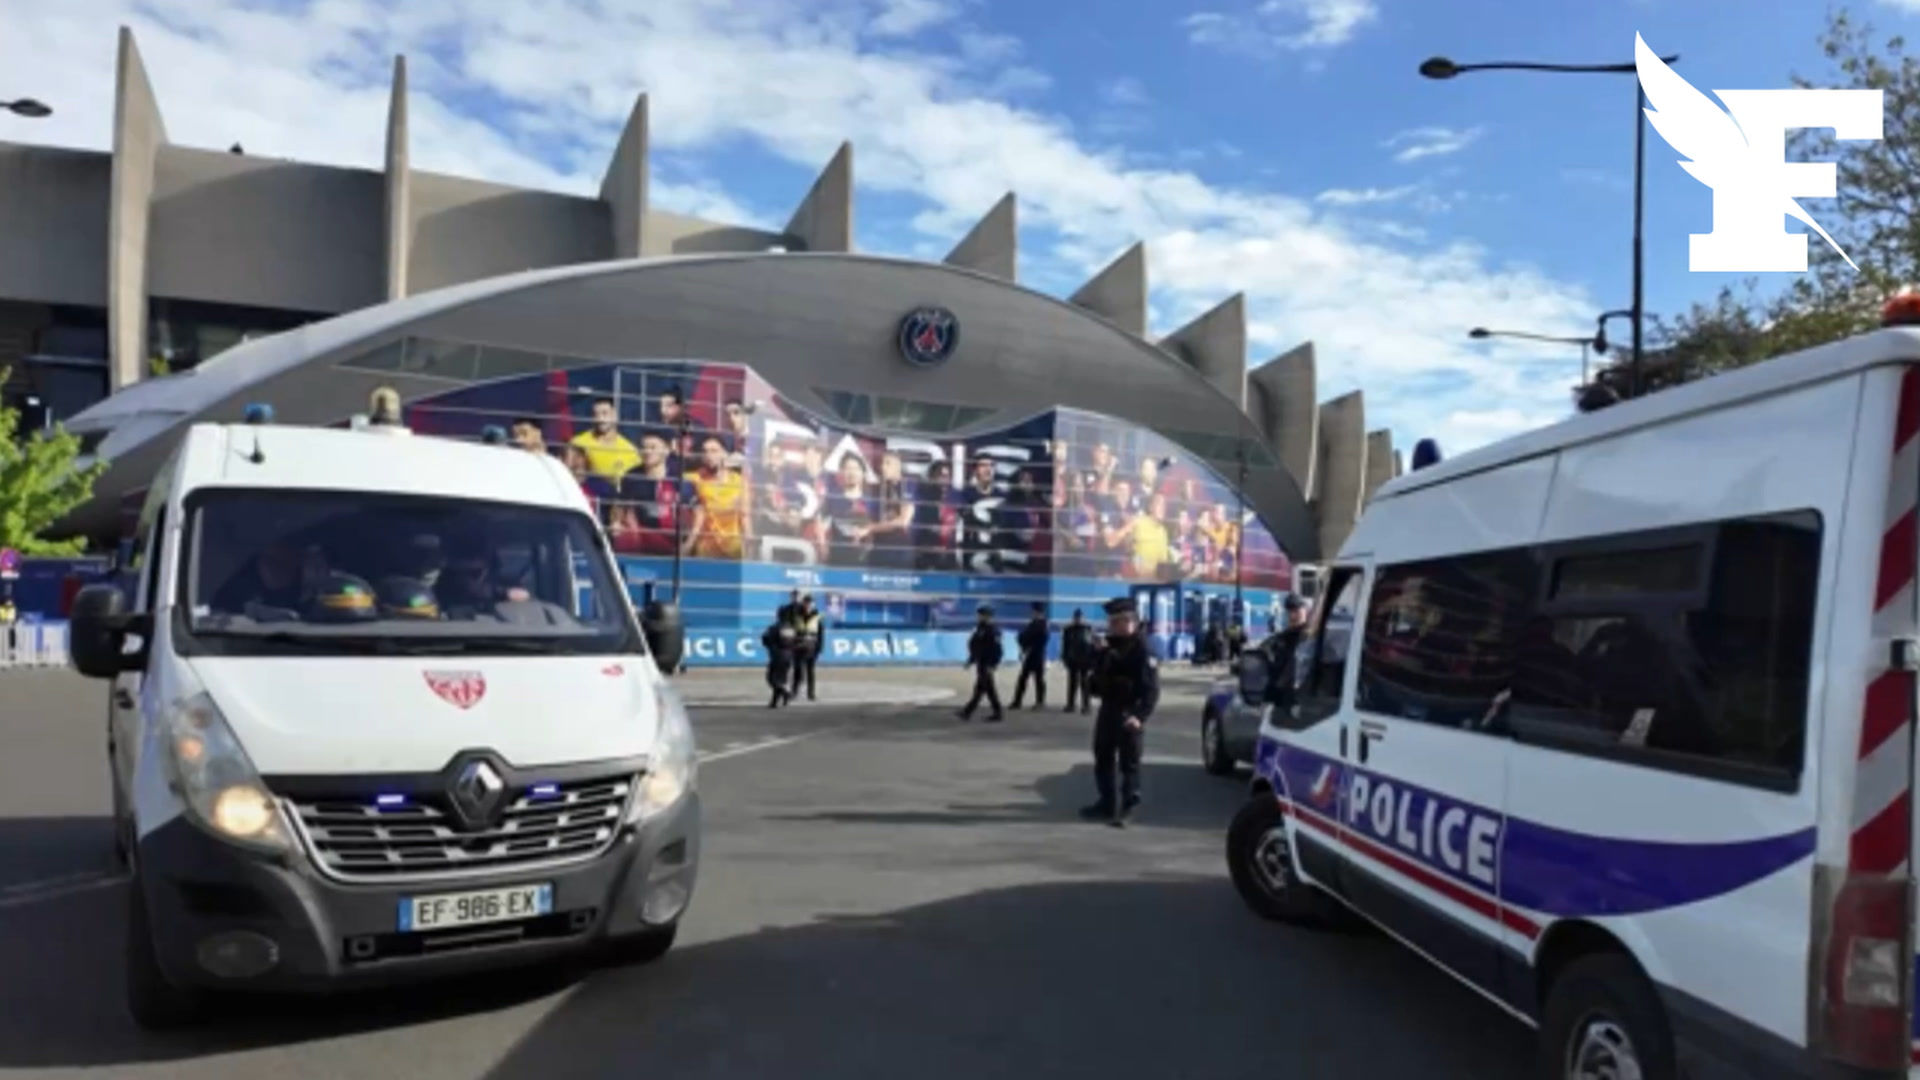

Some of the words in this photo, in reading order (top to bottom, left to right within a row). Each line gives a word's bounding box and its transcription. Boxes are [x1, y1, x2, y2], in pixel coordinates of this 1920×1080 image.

[683, 637, 726, 658] ICI
[832, 637, 920, 658] PARIS
[1350, 774, 1499, 884] POLICE
